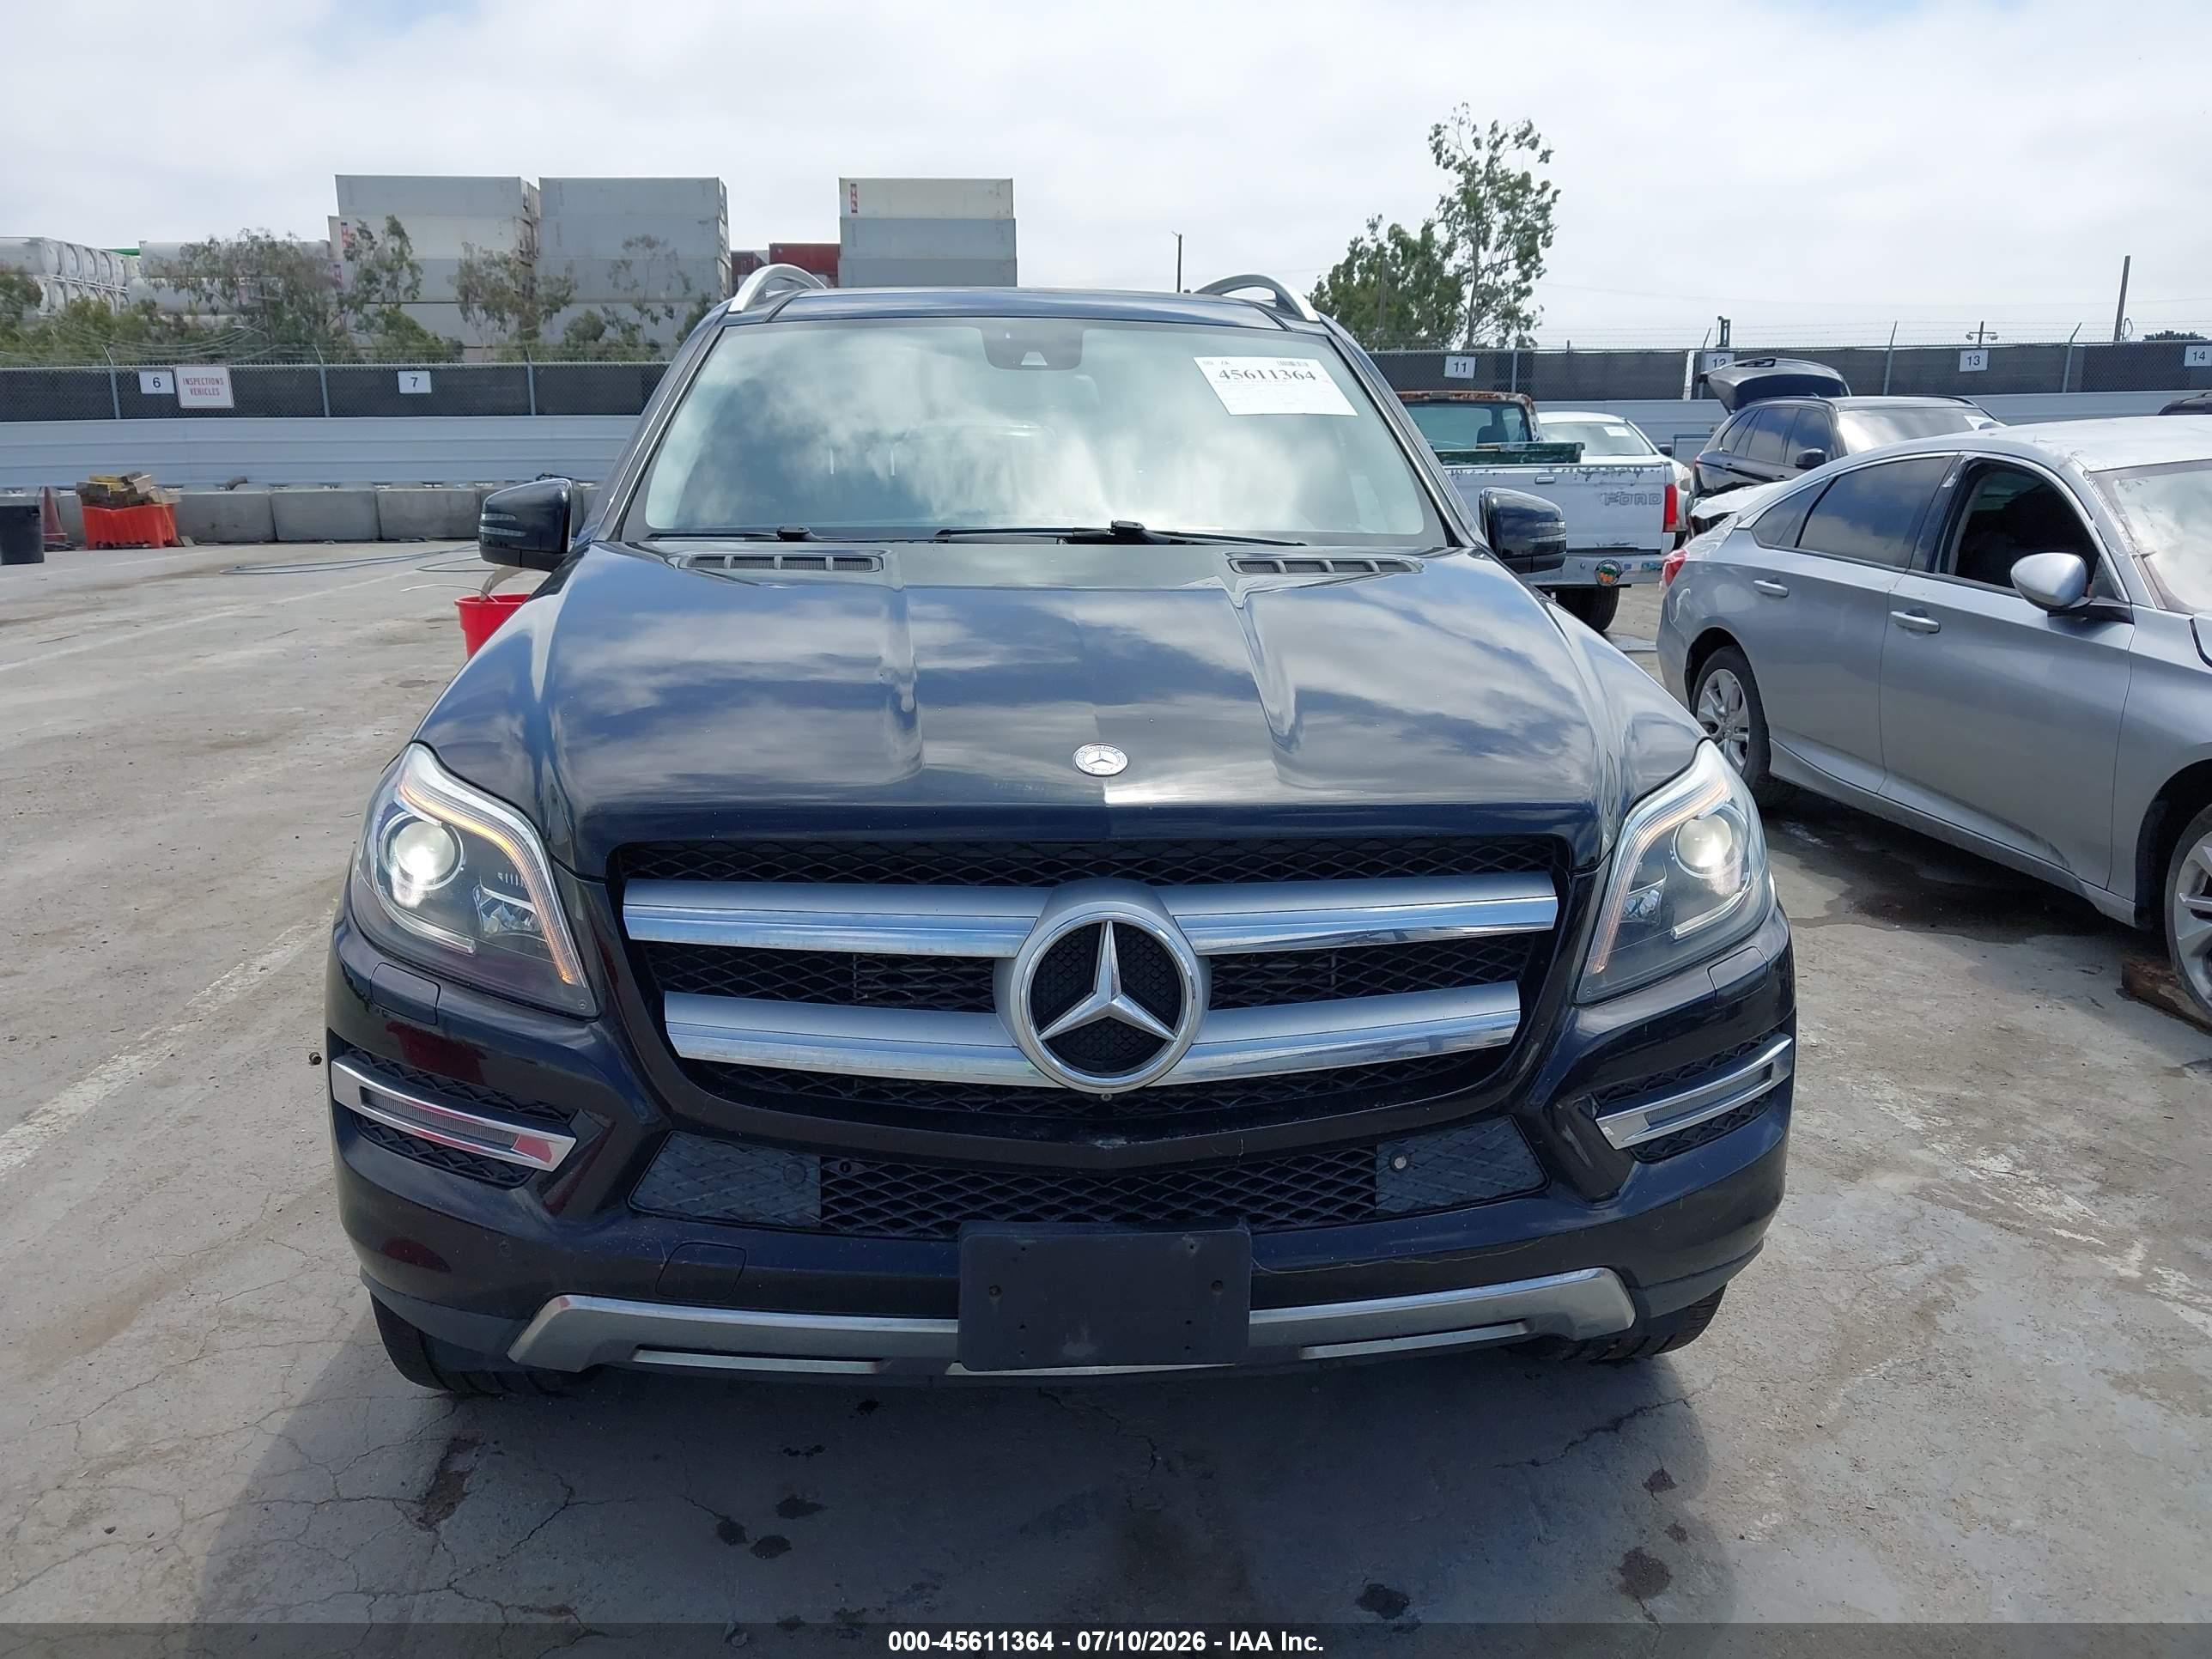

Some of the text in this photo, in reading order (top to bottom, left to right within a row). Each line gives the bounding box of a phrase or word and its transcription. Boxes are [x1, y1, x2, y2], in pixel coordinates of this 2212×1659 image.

[1966, 355, 1980, 366] 13
[2192, 350, 2206, 362] 14
[1453, 362, 1467, 373] 11
[1712, 358, 1727, 368] 12
[1218, 369, 1316, 380] 45611364
[152, 377, 161, 388] 6
[182, 377, 225, 386] INSPECTIONS
[410, 376, 418, 387] 7
[189, 387, 221, 396] VEHICLES
[1602, 492, 1662, 506] FORD
